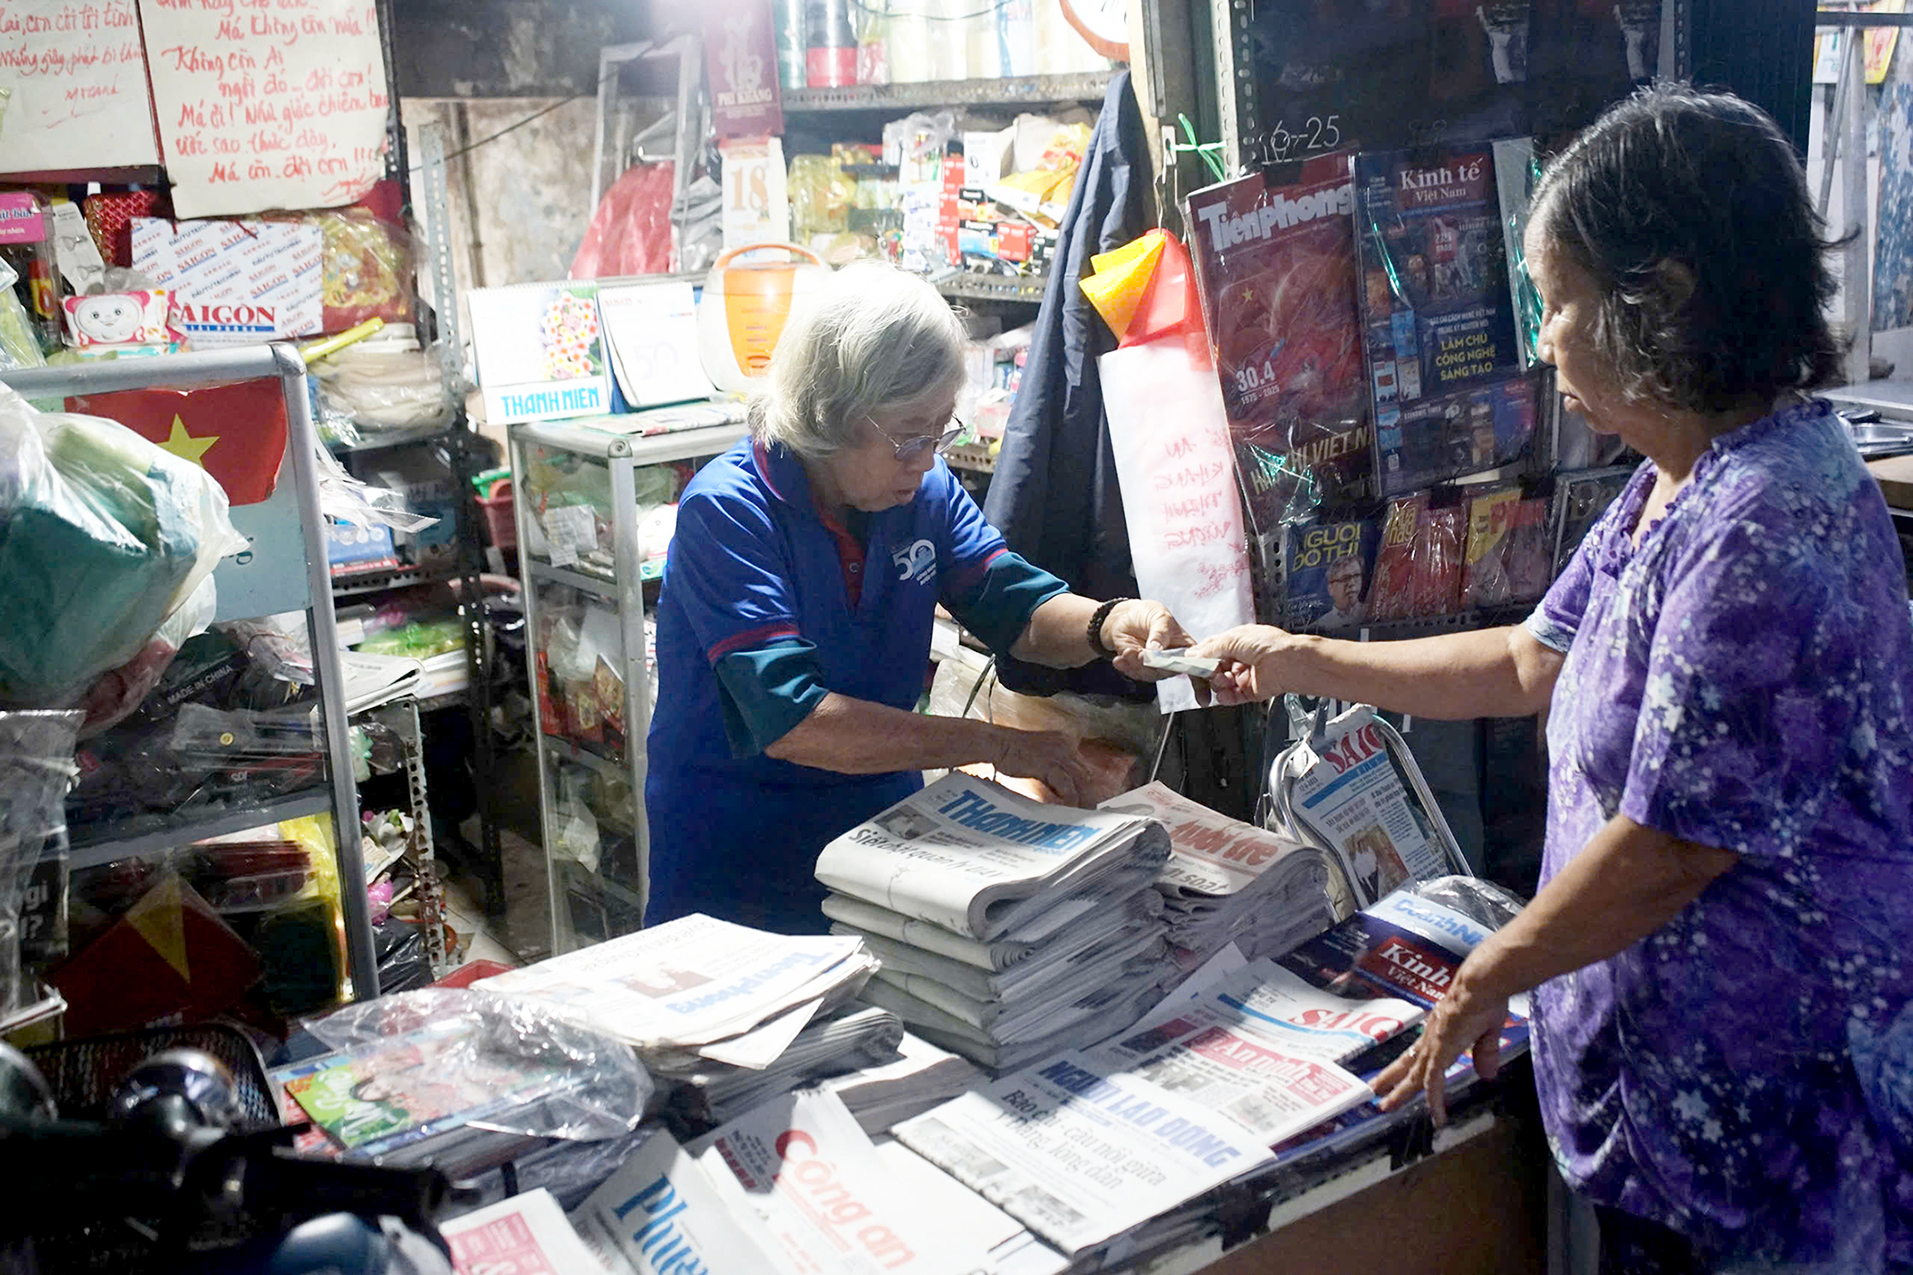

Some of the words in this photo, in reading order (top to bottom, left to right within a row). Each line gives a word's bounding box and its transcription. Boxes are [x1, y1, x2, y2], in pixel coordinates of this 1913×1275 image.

[730, 165, 769, 212] 18
[1400, 167, 1453, 190] Kinh
[1458, 156, 1484, 183] tế
[1415, 189, 1439, 203] Việt
[1439, 187, 1467, 199] Nam
[1435, 351, 1466, 367] CÔNG
[1441, 336, 1465, 351] LÀM
[1235, 360, 1275, 392] 30.4
[1440, 366, 1469, 381] SÁNG
[1240, 393, 1258, 405] 1975
[892, 539, 936, 581] 50
[167, 685, 195, 705] MADE
[194, 679, 206, 690] IN
[205, 664, 234, 684] CHINA
[1379, 943, 1451, 988] Kinh
[1386, 966, 1416, 988] Việt
[1221, 1038, 1257, 1065] An
[1252, 1047, 1314, 1084] ninh
[1106, 1094, 1170, 1127] LAO
[775, 1130, 873, 1226] Công
[857, 1225, 916, 1270] an
